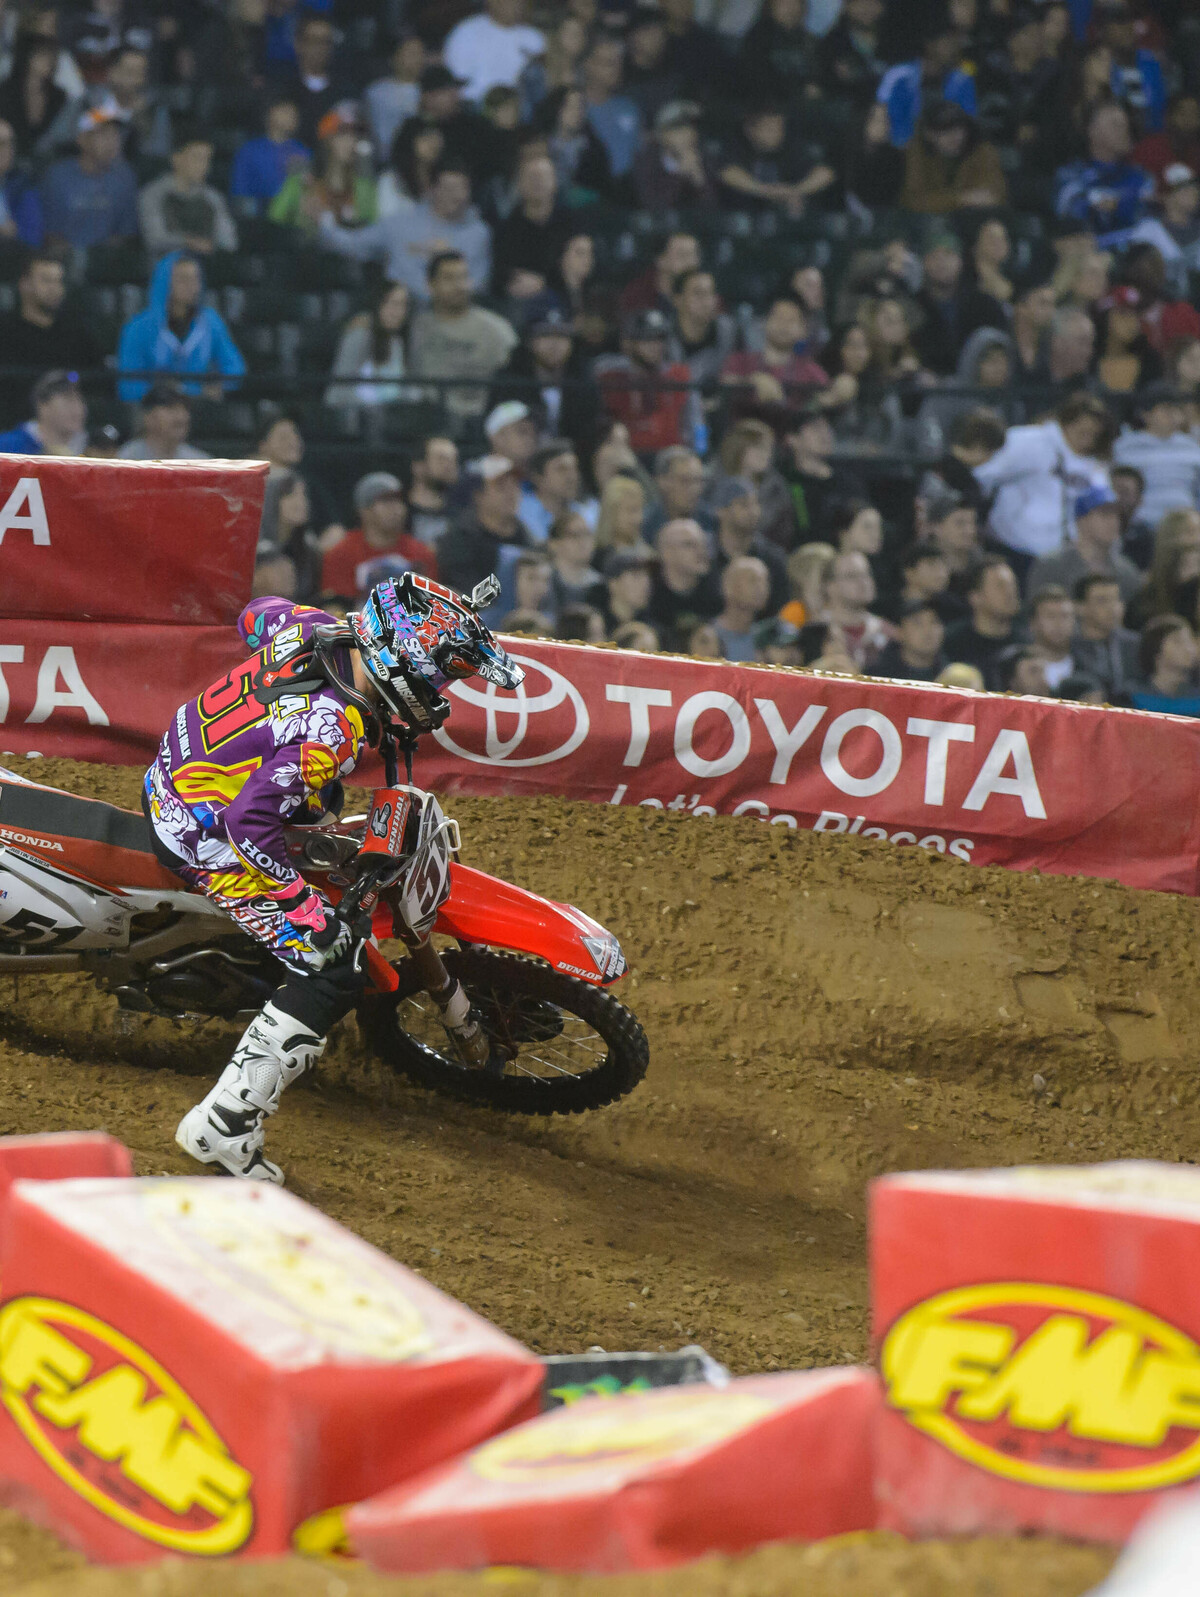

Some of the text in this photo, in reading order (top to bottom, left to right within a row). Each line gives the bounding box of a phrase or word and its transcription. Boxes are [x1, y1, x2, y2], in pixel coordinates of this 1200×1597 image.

[198, 650, 272, 756] 51
[178, 735, 193, 762] MILK
[605, 684, 1048, 820] TOYOTA
[0, 828, 65, 852] HONDA
[387, 795, 406, 855] RENTHAL
[556, 961, 603, 981] DUNLOP
[891, 1315, 1200, 1446] FMF
